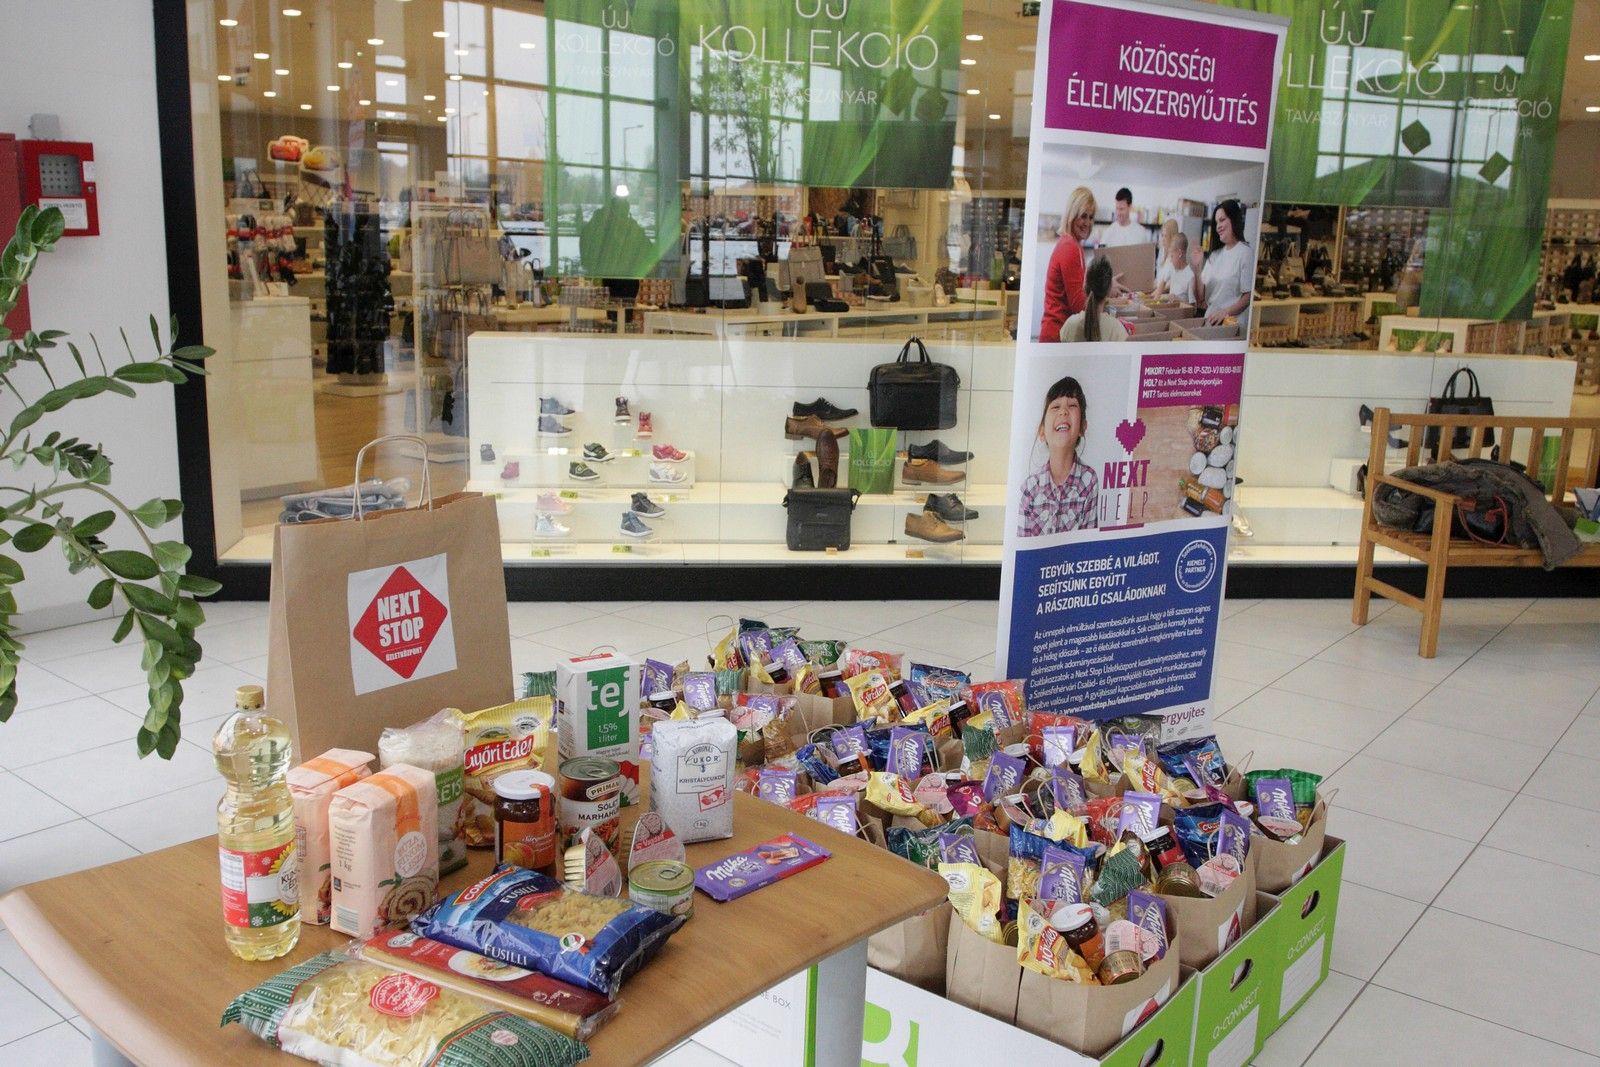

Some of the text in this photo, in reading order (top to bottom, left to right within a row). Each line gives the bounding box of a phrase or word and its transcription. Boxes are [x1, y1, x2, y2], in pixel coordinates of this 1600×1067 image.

[602, 9, 629, 31] ÚJ
[1320, 0, 1369, 46] ÚJ
[697, 23, 939, 71] KOLLEKCIÓ
[1119, 40, 1216, 83] KÖZÖSSÉGI
[1067, 71, 1259, 126] ÉLELMISZERGYŰJTÉS
[1143, 378, 1158, 388] HOL?
[1167, 378, 1177, 386] Next
[1177, 378, 1188, 387] Stop
[1144, 366, 1165, 376] MIKOR?
[1165, 366, 1181, 375] Február
[1142, 389, 1156, 399] MIT?
[1102, 459, 1151, 490] NEXT
[1099, 491, 1149, 522] HELP
[1040, 551, 1161, 580] TEGYÜK SZEBBÉ A VILÁGOT,
[1036, 583, 1167, 615] A RÁSZORULÓ CSALÁDOKNAK!
[1038, 572, 1128, 599] SEGÍTSÜNK EGYÜTT
[376, 588, 422, 622] NEXT
[378, 616, 425, 648] STOP
[1033, 642, 1048, 654] egyet
[1048, 639, 1063, 651] jelent
[1068, 633, 1098, 645] magasabb
[1098, 627, 1131, 641] kiadásokkal
[1137, 624, 1148, 634] Sok
[1147, 621, 1167, 632] családra
[1167, 618, 1188, 628] komoly
[1188, 615, 1205, 625] terhet
[1034, 631, 1042, 640] Az
[1042, 626, 1066, 639] ünnepek
[1066, 620, 1096, 633] elmúltával
[1096, 615, 1136, 629] szembesülünk
[1150, 611, 1162, 622] hogy
[1167, 607, 1175, 616] téli
[1175, 607, 1194, 616] szezon
[1194, 604, 1211, 615] sajnos
[1032, 655, 1039, 664] ró
[1043, 651, 1059, 663] hideg
[1058, 647, 1080, 660] időszak
[1085, 646, 1093, 654] az
[1098, 641, 1121, 653] életüket
[1121, 635, 1149, 649] szeretnénk
[1187, 626, 1203, 636] tartós
[1030, 674, 1070, 688] Csatlakozzatok
[1075, 669, 1089, 679] Next
[1089, 667, 1103, 678] Stop
[1103, 662, 1138, 675] Üzletközpont
[1190, 648, 1208, 658] amely
[1031, 663, 1064, 677] élelmiszerek
[1033, 683, 1077, 700] Székesfehérvári
[1098, 677, 1106, 685] és
[1143, 666, 1163, 678] Központ
[1162, 658, 1203, 673] munkatársaival
[587, 669, 630, 718] tej
[1049, 696, 1070, 706] valósul
[1084, 691, 1090, 700] A
[1117, 680, 1147, 694] kapcsolatos
[1147, 676, 1167, 687] minden
[1166, 671, 1197, 684] információt
[1161, 704, 1206, 727] ergyujtes
[463, 736, 534, 771] Győri Édes
[602, 733, 618, 742] liter
[903, 738, 920, 774] Milka
[679, 773, 726, 785] KRISTÁLYCUKOR
[705, 854, 749, 881] Milka
[499, 884, 540, 904] FUSILLI
[1059, 863, 1079, 905] Milka
[1286, 915, 1325, 962] Q-CONNECT
[483, 943, 528, 967] FUSILLI
[772, 994, 792, 1010] BOX
[1211, 987, 1259, 1042] Q-CONNECT
